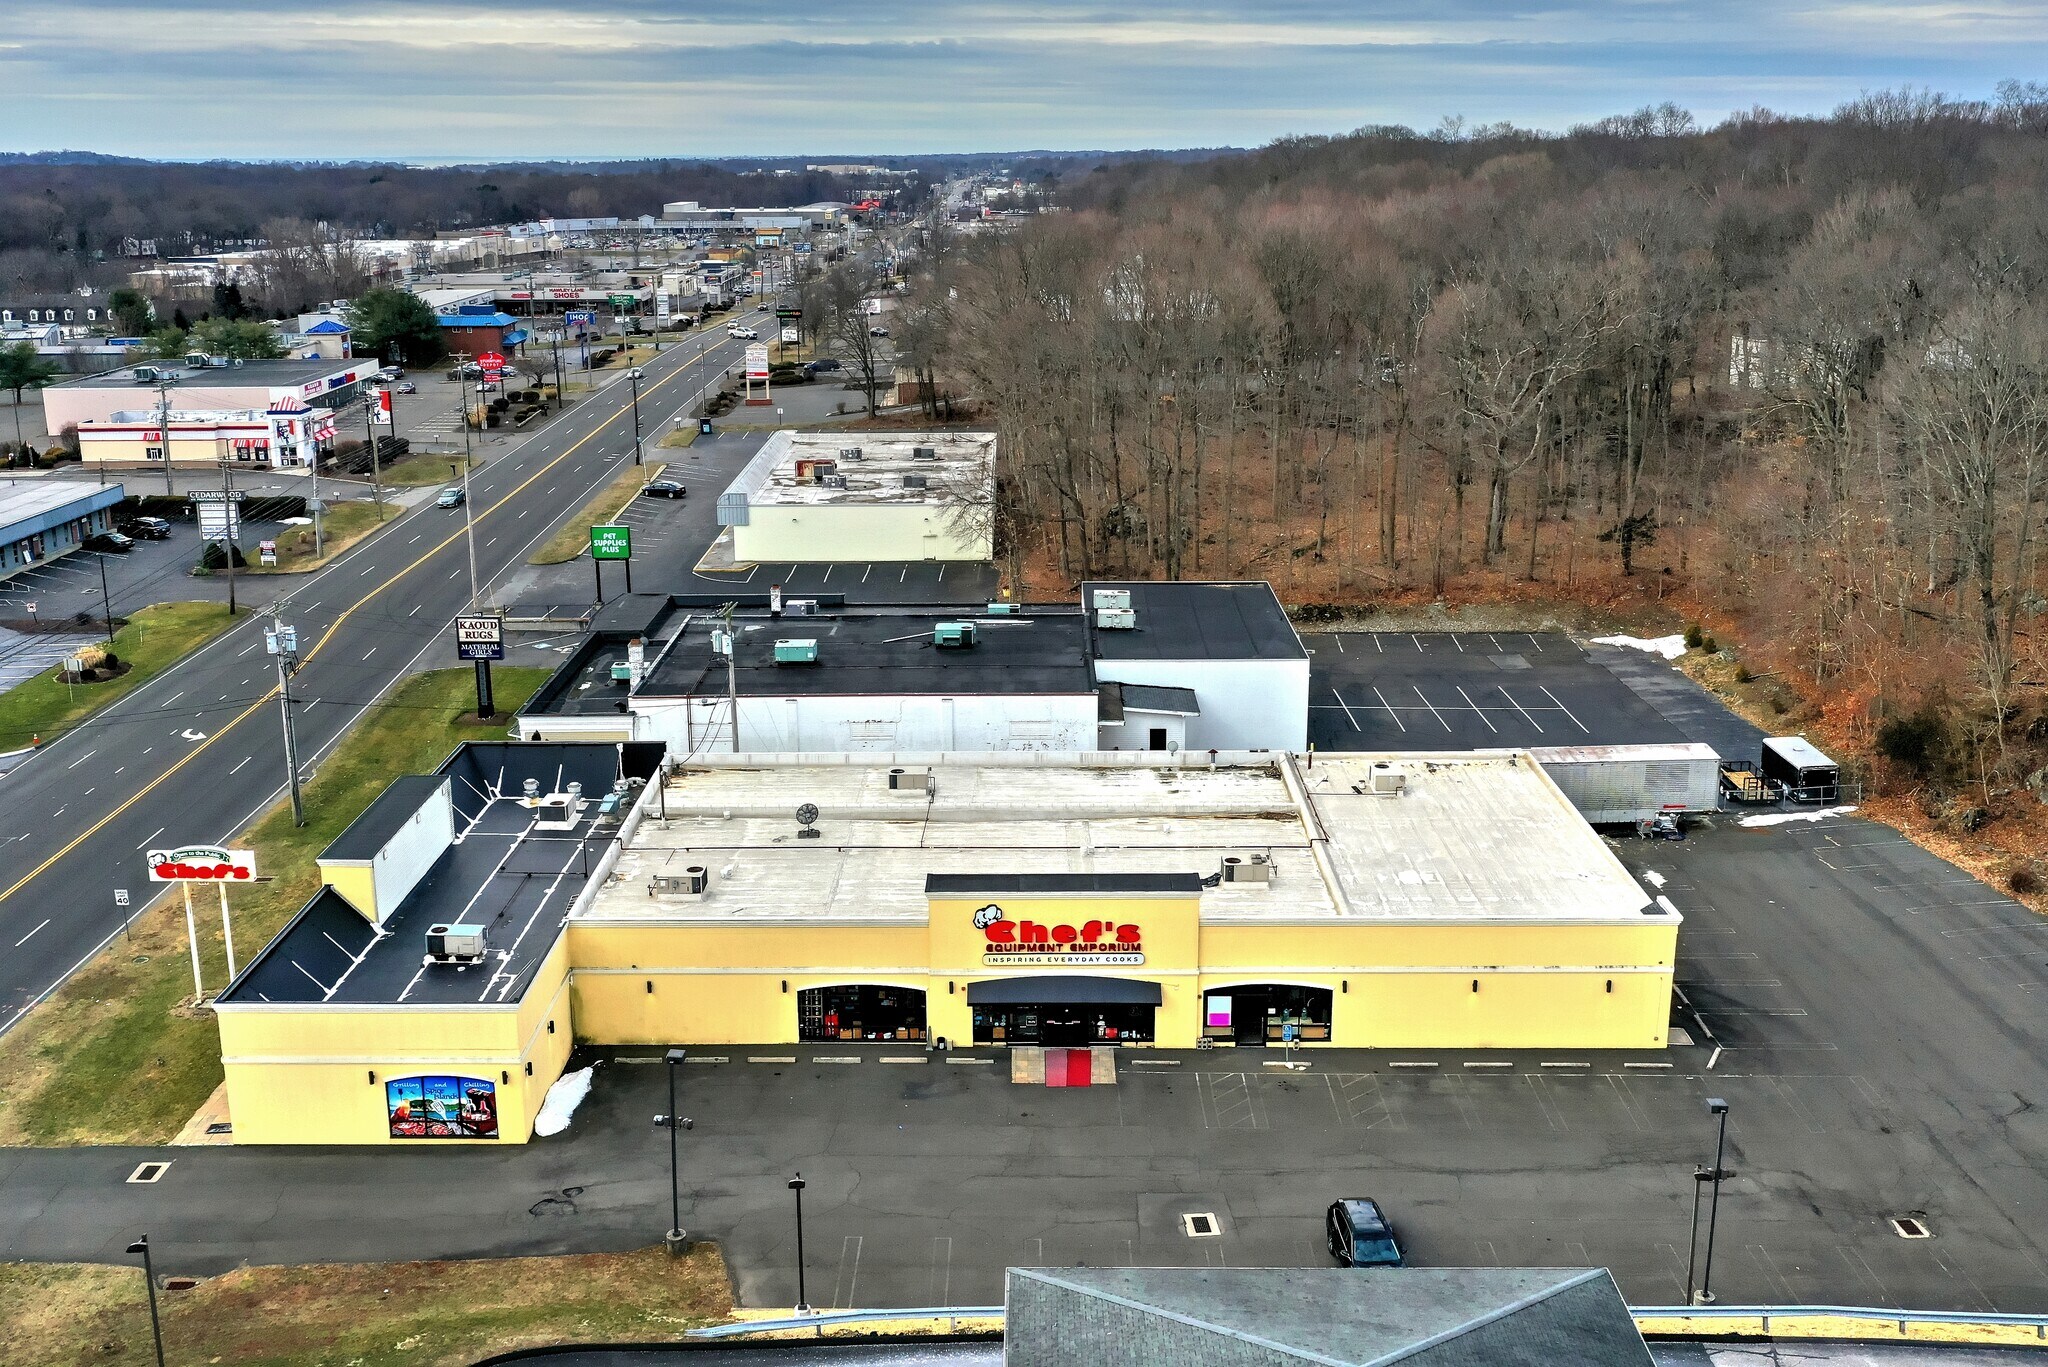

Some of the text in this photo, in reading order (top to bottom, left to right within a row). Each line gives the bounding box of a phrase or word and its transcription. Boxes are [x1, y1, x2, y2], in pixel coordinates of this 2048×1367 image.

[459, 621, 498, 630] KAOUD
[465, 631, 493, 639] RUGS
[461, 643, 500, 651] MATERIAL
[173, 851, 187, 859] Open
[204, 850, 222, 858] Public
[985, 920, 1141, 944] Chef's
[985, 943, 1141, 953] EQUIPMENT EMPORIUM
